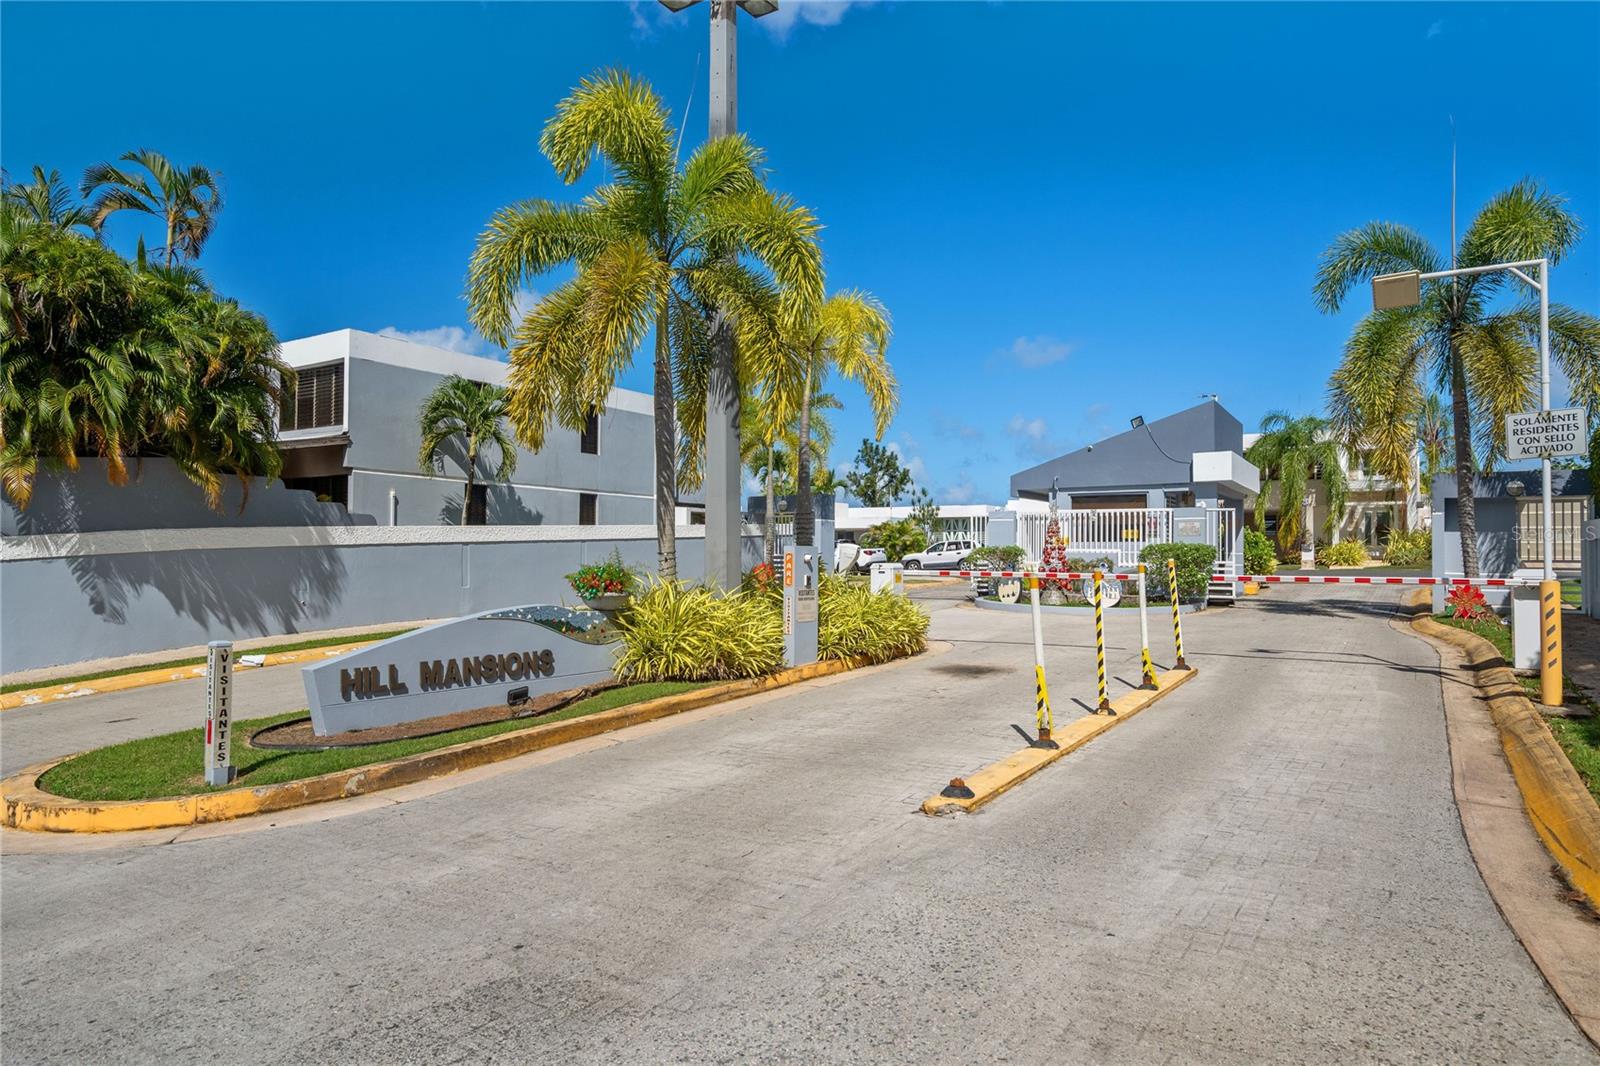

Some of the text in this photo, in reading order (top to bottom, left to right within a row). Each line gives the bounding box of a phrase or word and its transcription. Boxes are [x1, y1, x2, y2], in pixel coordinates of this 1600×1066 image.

[1513, 413, 1578, 427] SOLAMENTE
[1512, 423, 1579, 436] RESIDENTES
[1517, 433, 1576, 445] CON SELLO
[1520, 442, 1574, 455] ACTIVADO
[340, 649, 555, 701] HILL MANSIONS
[217, 654, 229, 761] VISITANTES
